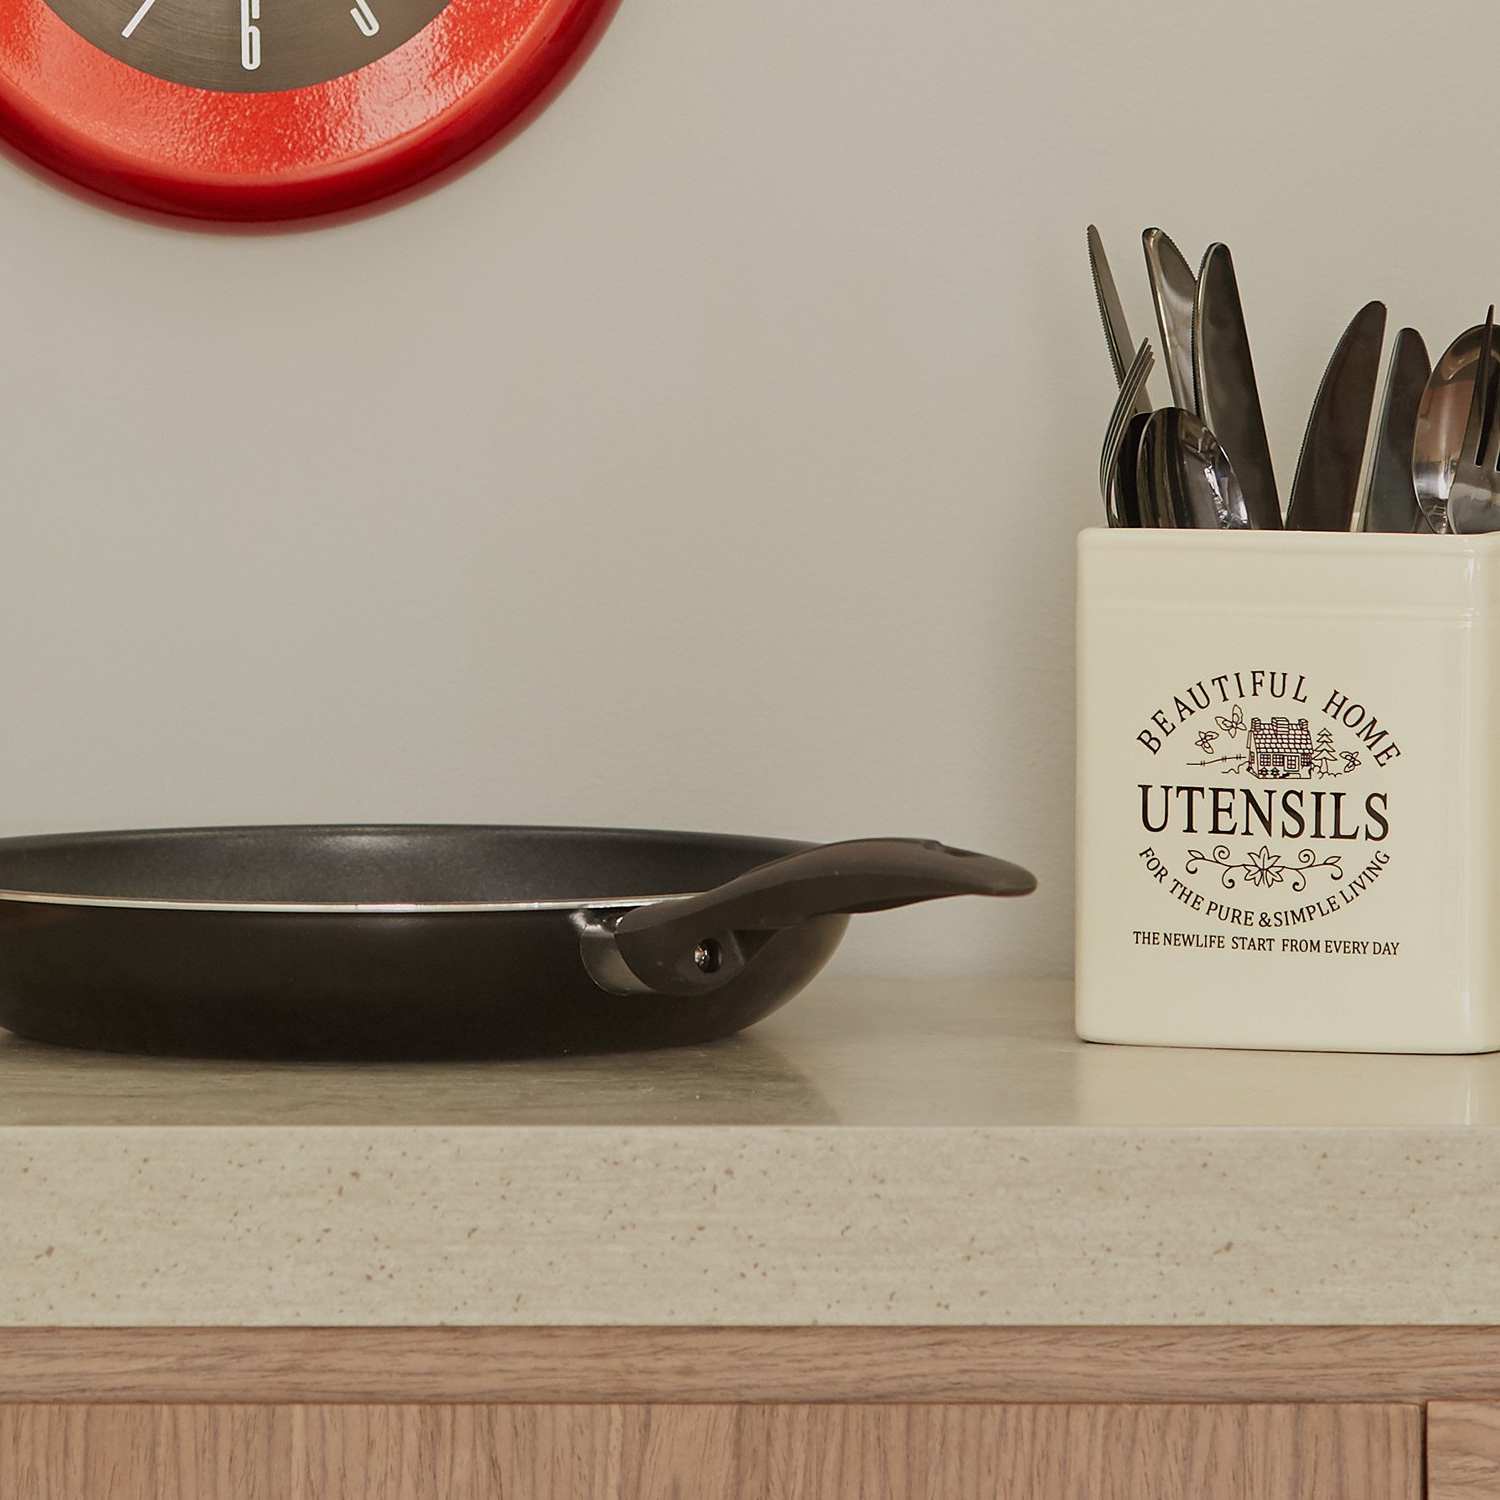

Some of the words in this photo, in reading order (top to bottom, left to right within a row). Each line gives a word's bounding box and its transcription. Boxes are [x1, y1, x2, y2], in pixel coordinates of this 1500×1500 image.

[1136, 670, 1308, 755] BEAUTIFUL
[1322, 689, 1402, 768] HOME
[1138, 784, 1390, 842] UTENSILS
[1138, 847, 1167, 884] FOR
[1168, 878, 1203, 911] THE
[1205, 902, 1254, 927] PURE
[1339, 850, 1390, 905] LIVING
[1133, 931, 1160, 946] THE
[1162, 933, 1225, 949] NEWLIFE
[1231, 936, 1275, 952] START
[1282, 939, 1321, 953] FROM
[1325, 940, 1369, 955] EVERY
[1372, 942, 1400, 956] DAY
